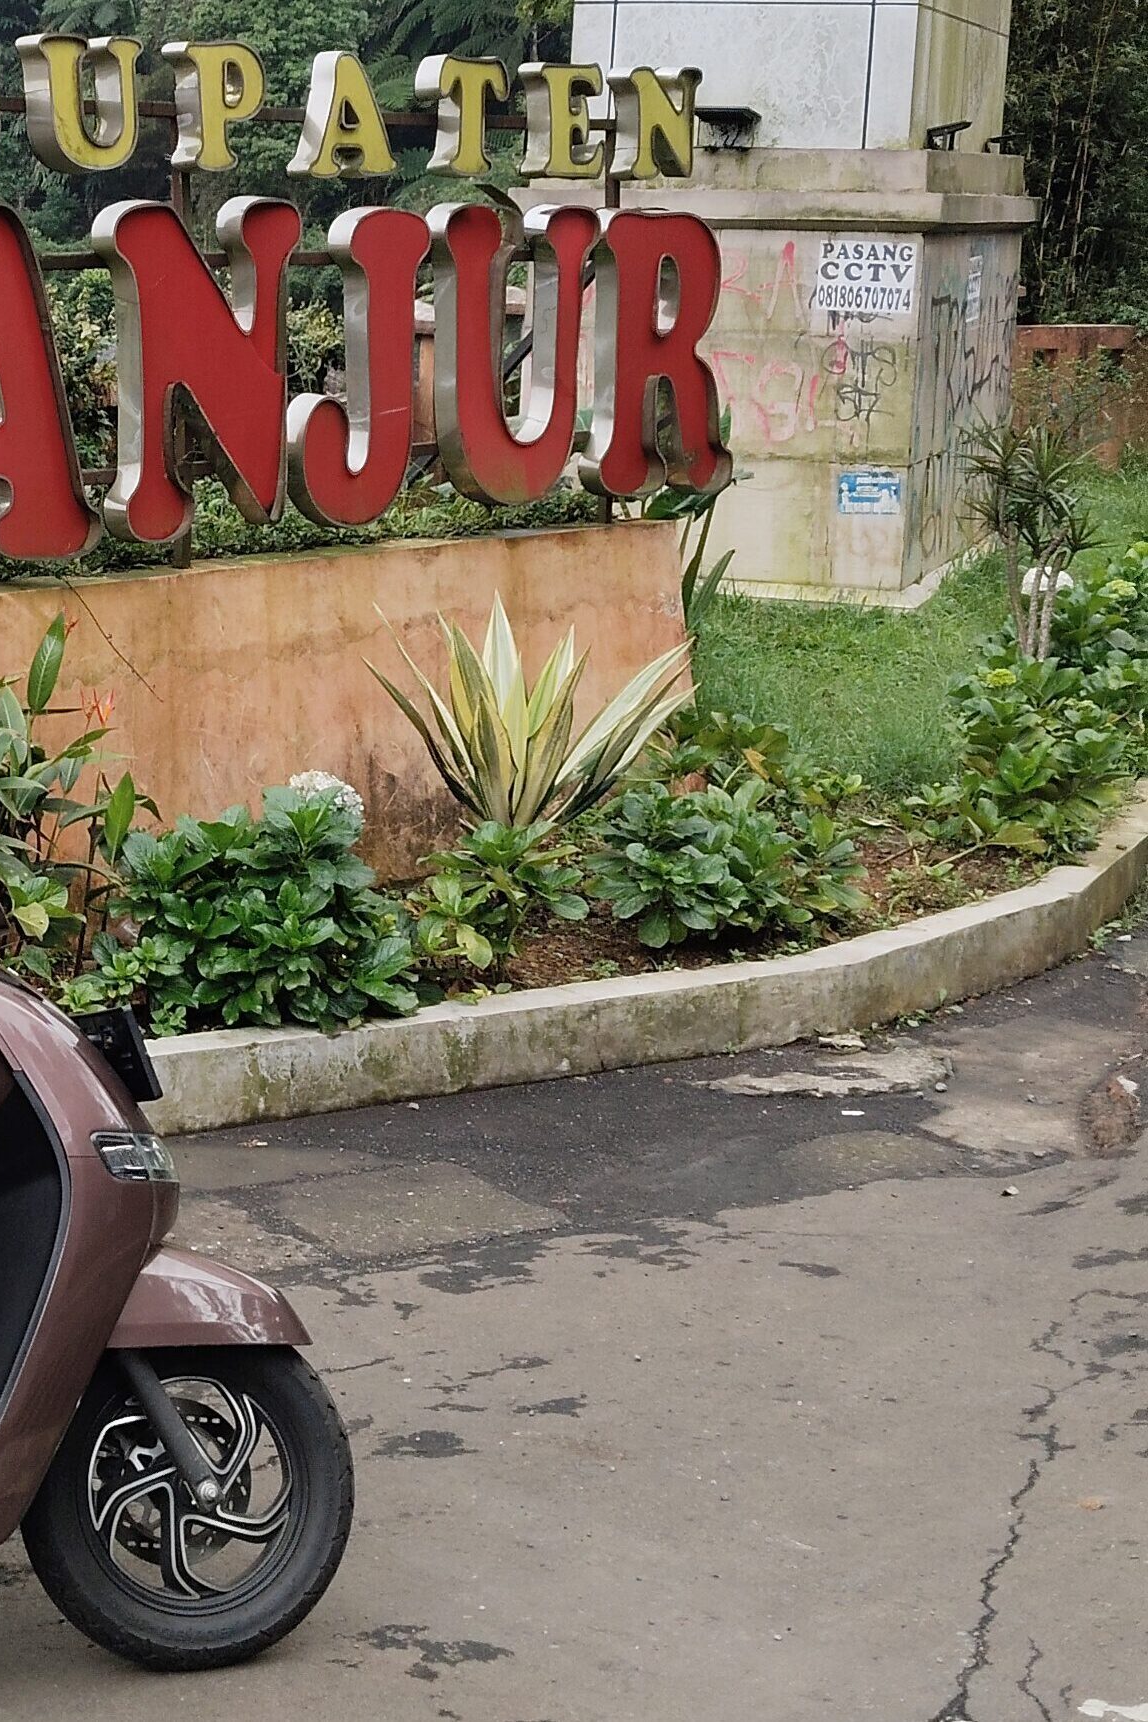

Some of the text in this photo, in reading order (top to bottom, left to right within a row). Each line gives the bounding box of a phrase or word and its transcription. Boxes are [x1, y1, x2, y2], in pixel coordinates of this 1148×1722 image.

[822, 242, 913, 262] PASANG
[820, 261, 913, 283] CCTV
[818, 284, 911, 311] 081806707074
